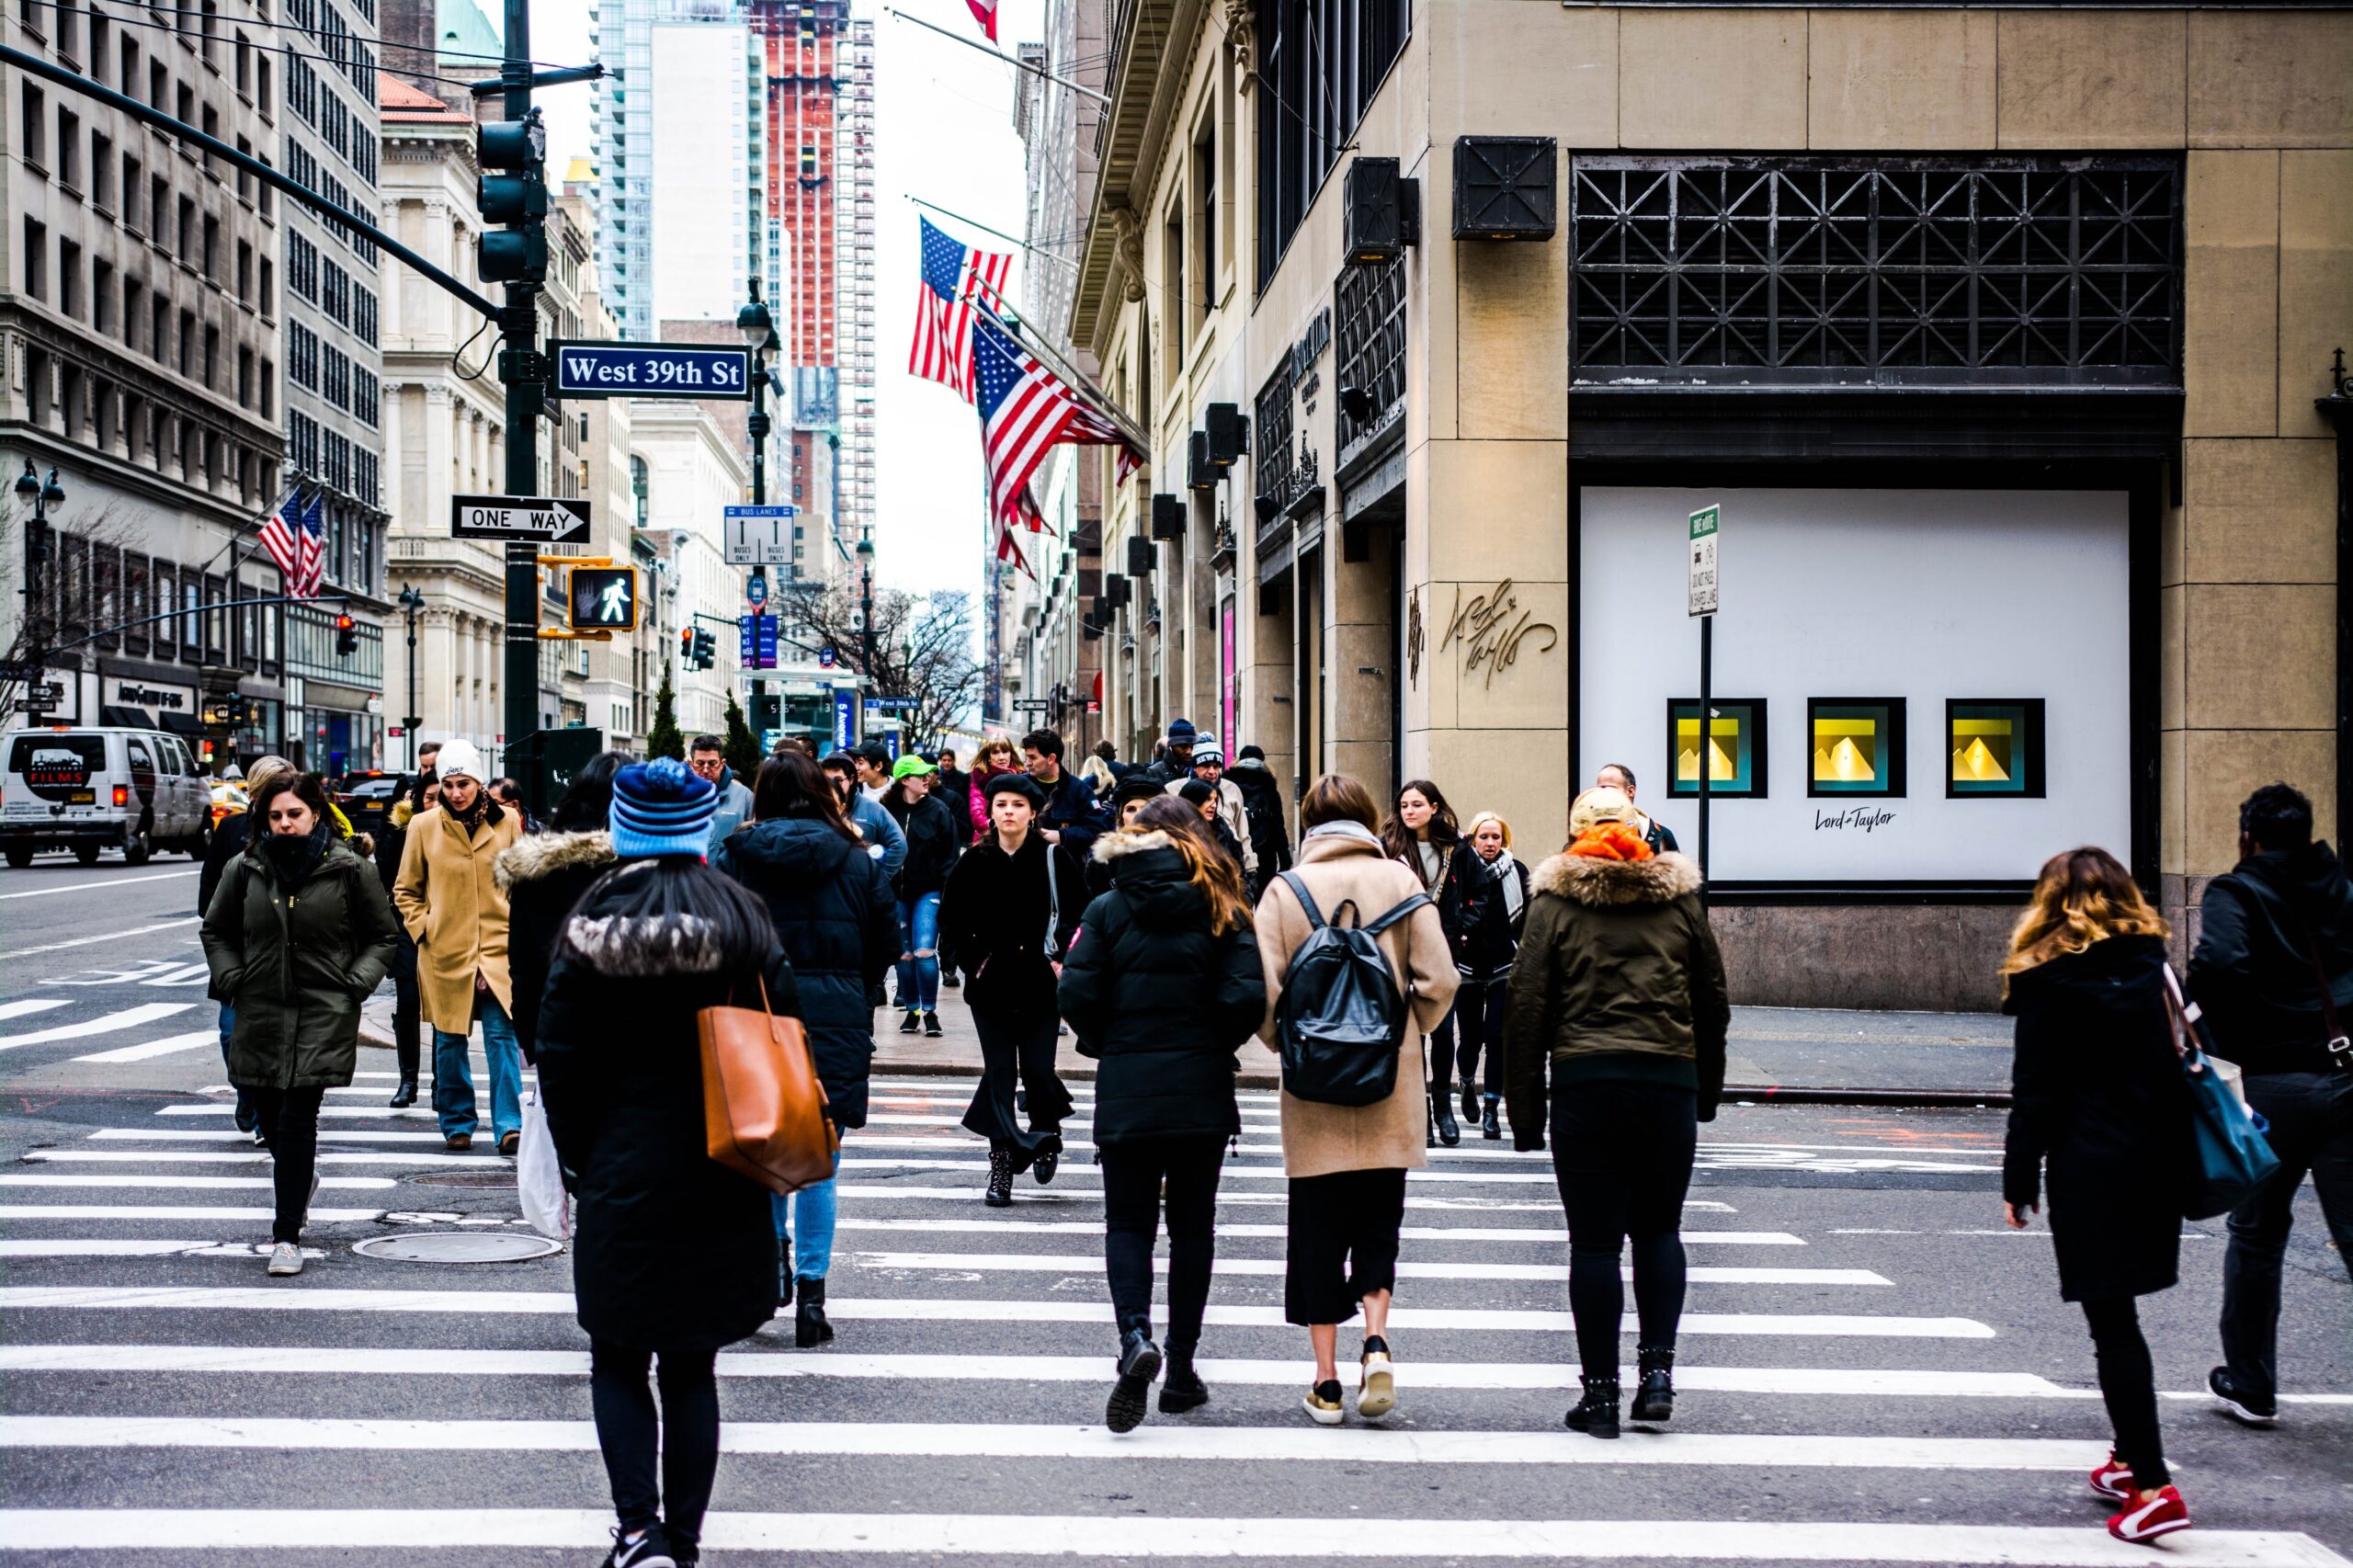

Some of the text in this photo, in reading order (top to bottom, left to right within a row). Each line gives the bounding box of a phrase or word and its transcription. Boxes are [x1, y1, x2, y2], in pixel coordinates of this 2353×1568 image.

[566, 358, 740, 385] West 39th St
[472, 509, 570, 530] ONE WAY
[838, 711, 847, 747] Avenue
[30, 773, 83, 782] FILMS
[1814, 808, 1846, 831] Lord
[1850, 806, 1897, 834] Taylor
